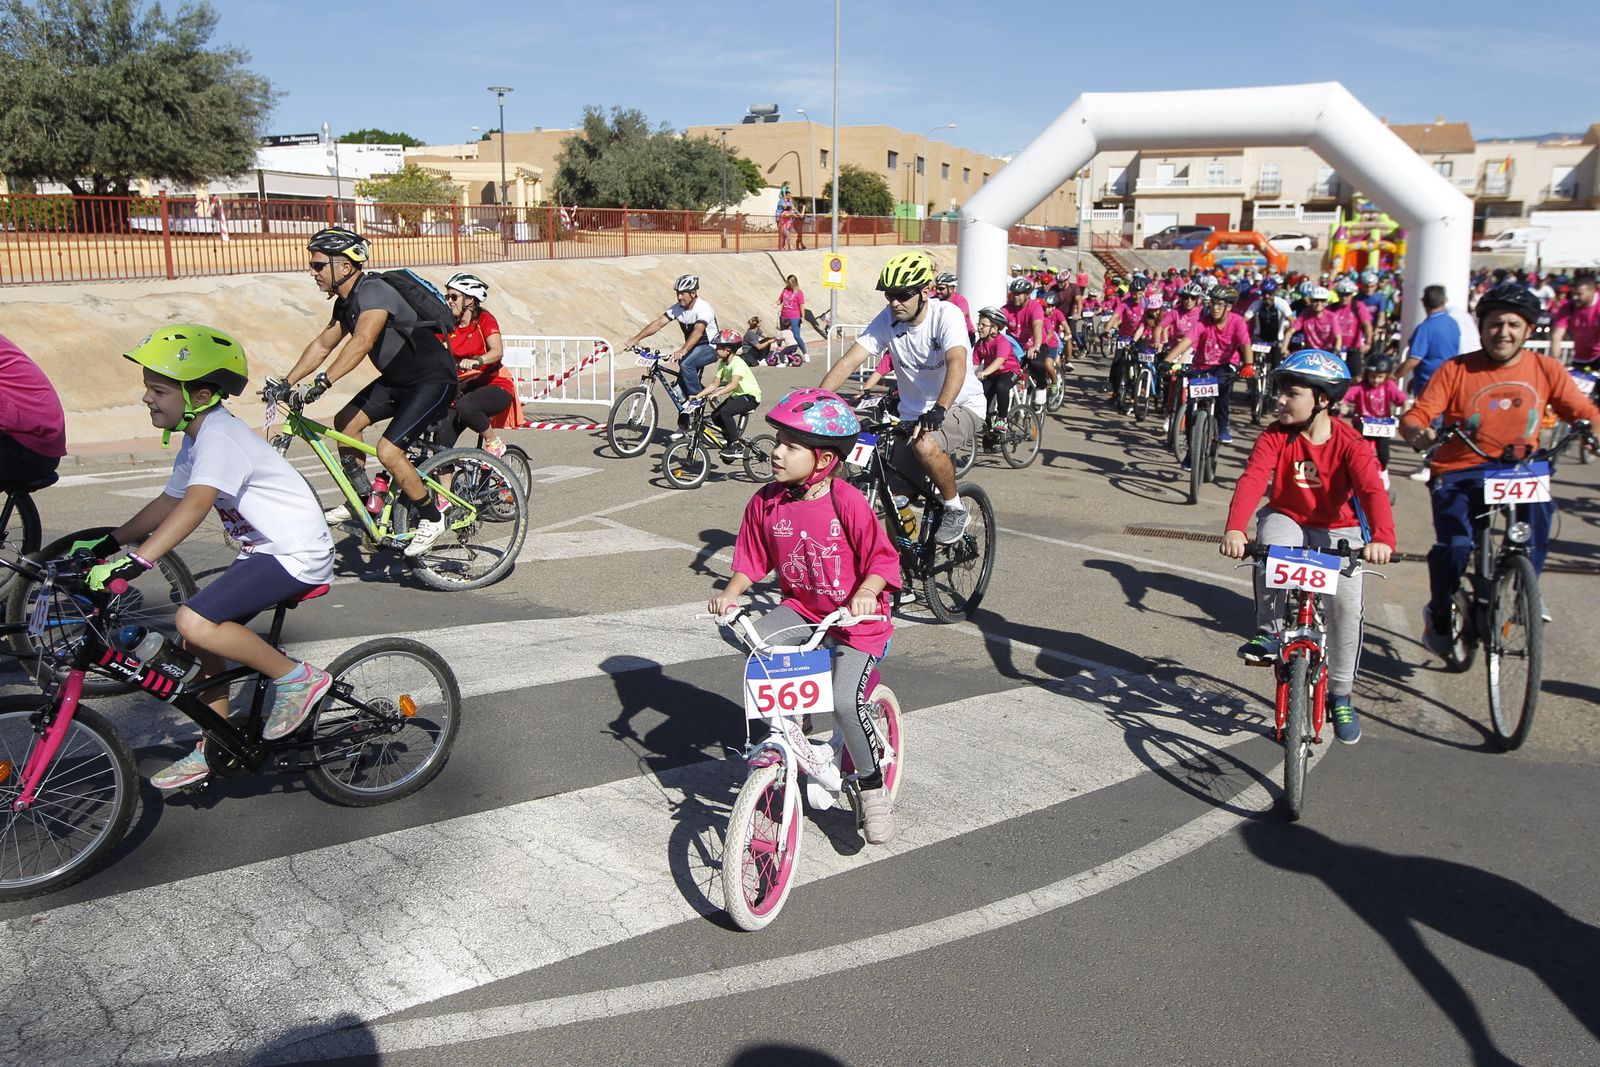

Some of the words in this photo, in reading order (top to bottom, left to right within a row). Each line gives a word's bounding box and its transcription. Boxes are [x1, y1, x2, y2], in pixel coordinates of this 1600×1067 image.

[1193, 386, 1215, 396] 504
[1367, 425, 1390, 435] 373
[1492, 481, 1538, 500] 547
[1273, 563, 1327, 588] 548
[109, 661, 145, 681] BTWN
[757, 680, 820, 713] 569
